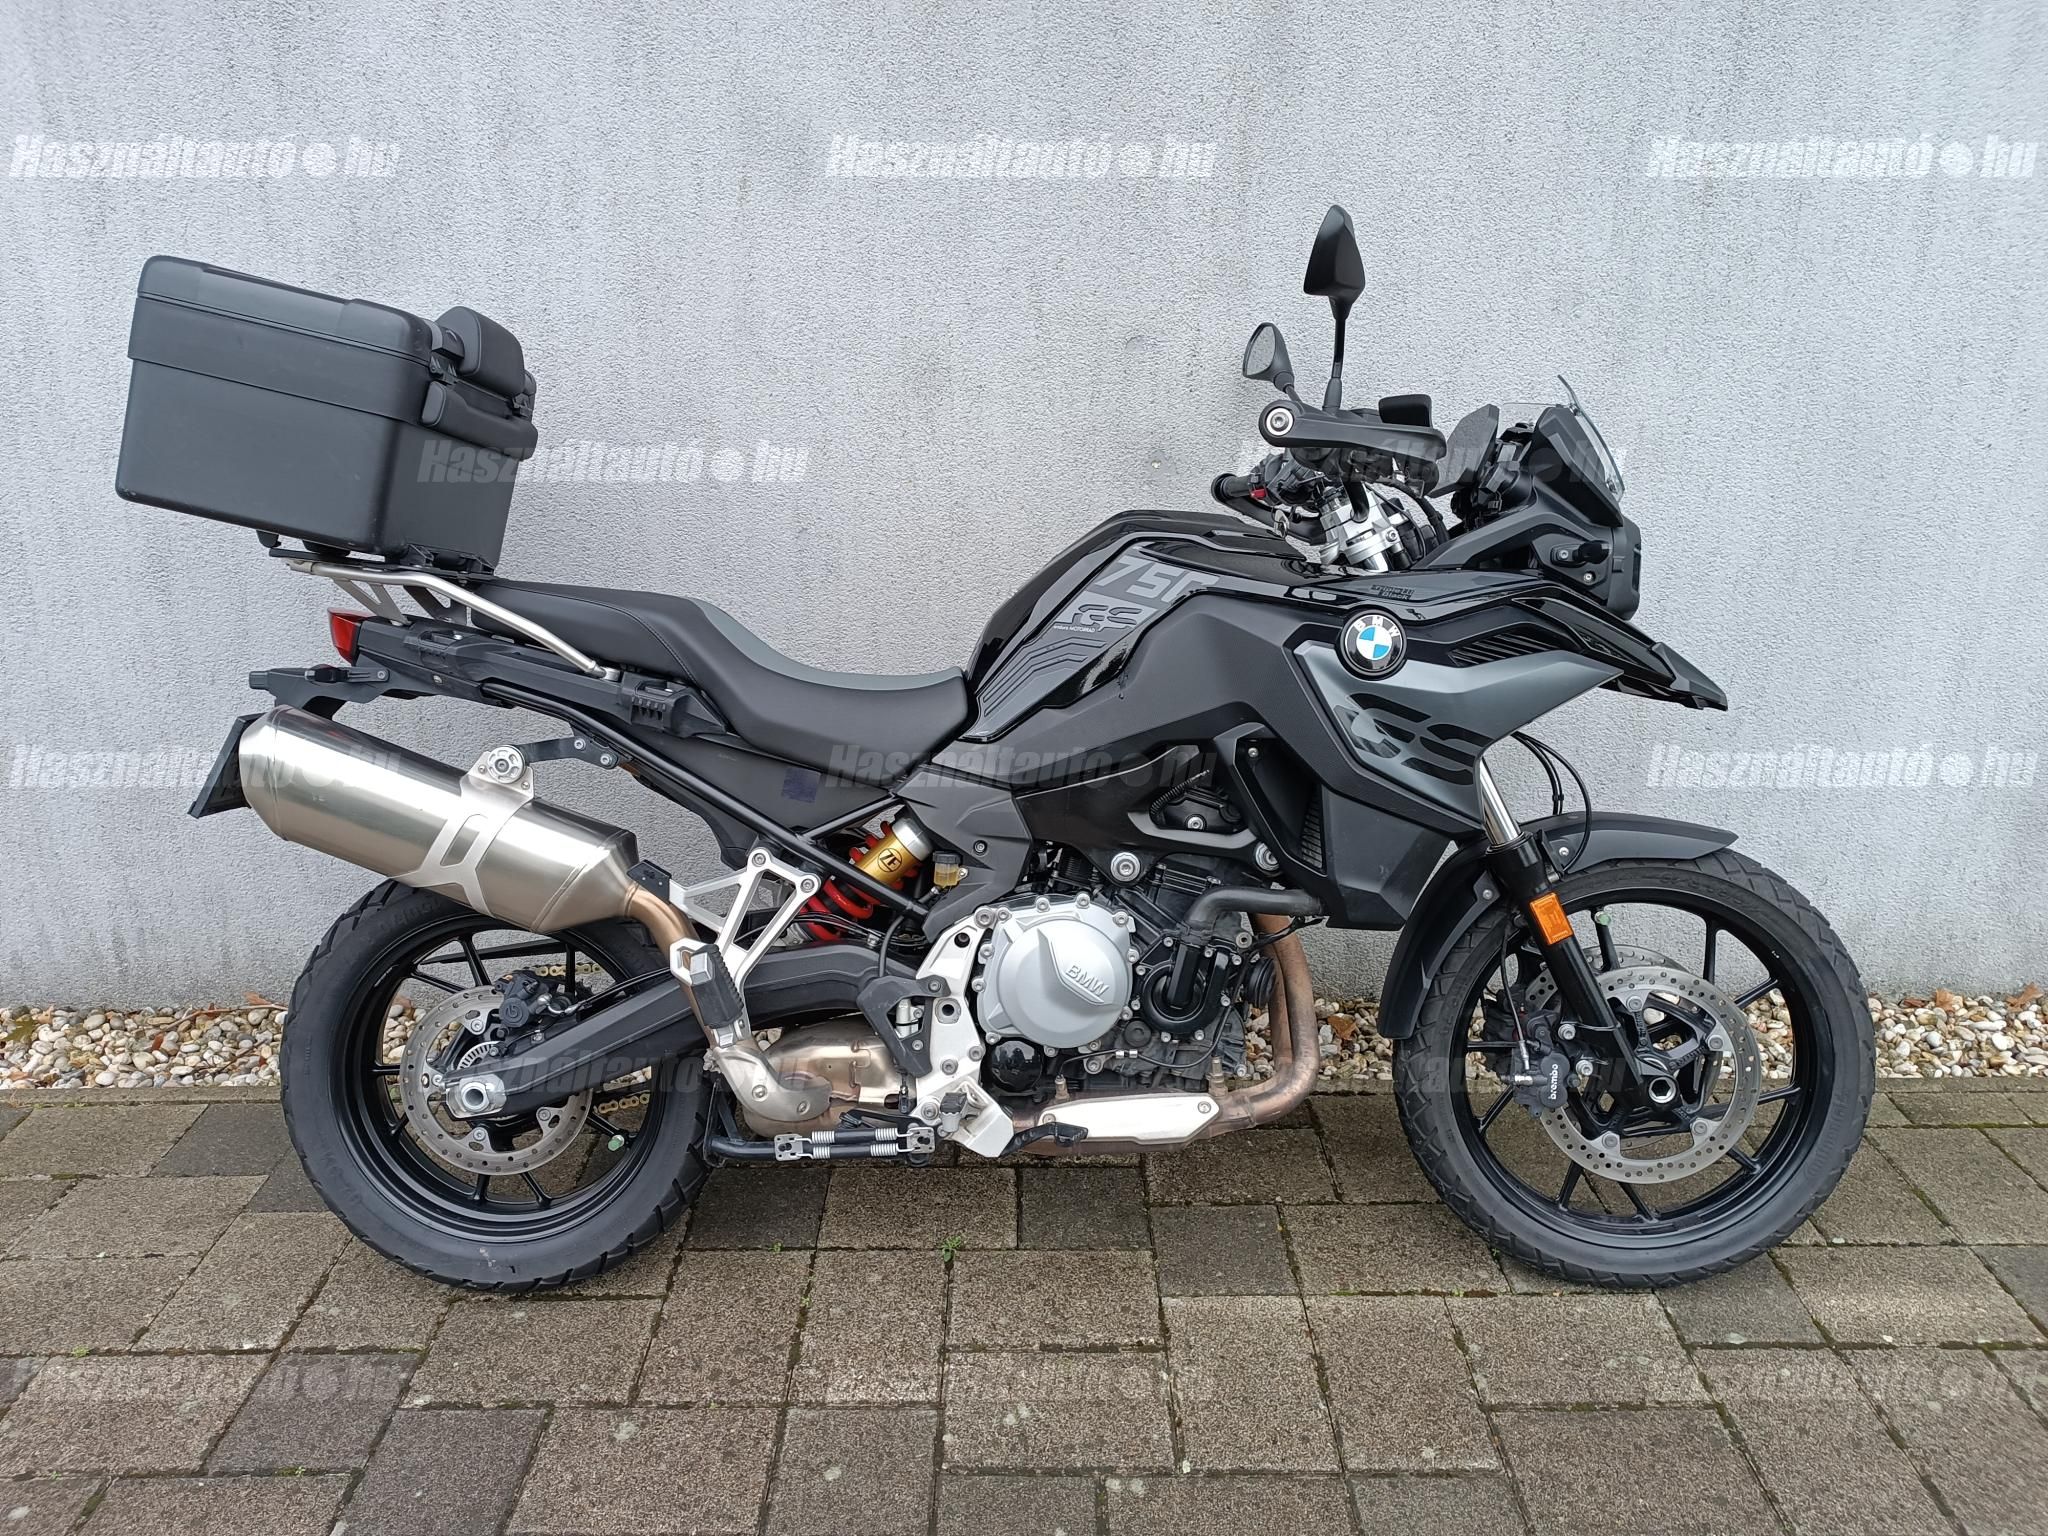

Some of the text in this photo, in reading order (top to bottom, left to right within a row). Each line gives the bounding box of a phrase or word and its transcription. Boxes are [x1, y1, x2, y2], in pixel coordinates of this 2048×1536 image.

[1353, 615, 1401, 637] BMW
[878, 848, 902, 872] ZF
[1065, 965, 1110, 997] BMW
[1548, 1064, 1558, 1099] brembo
